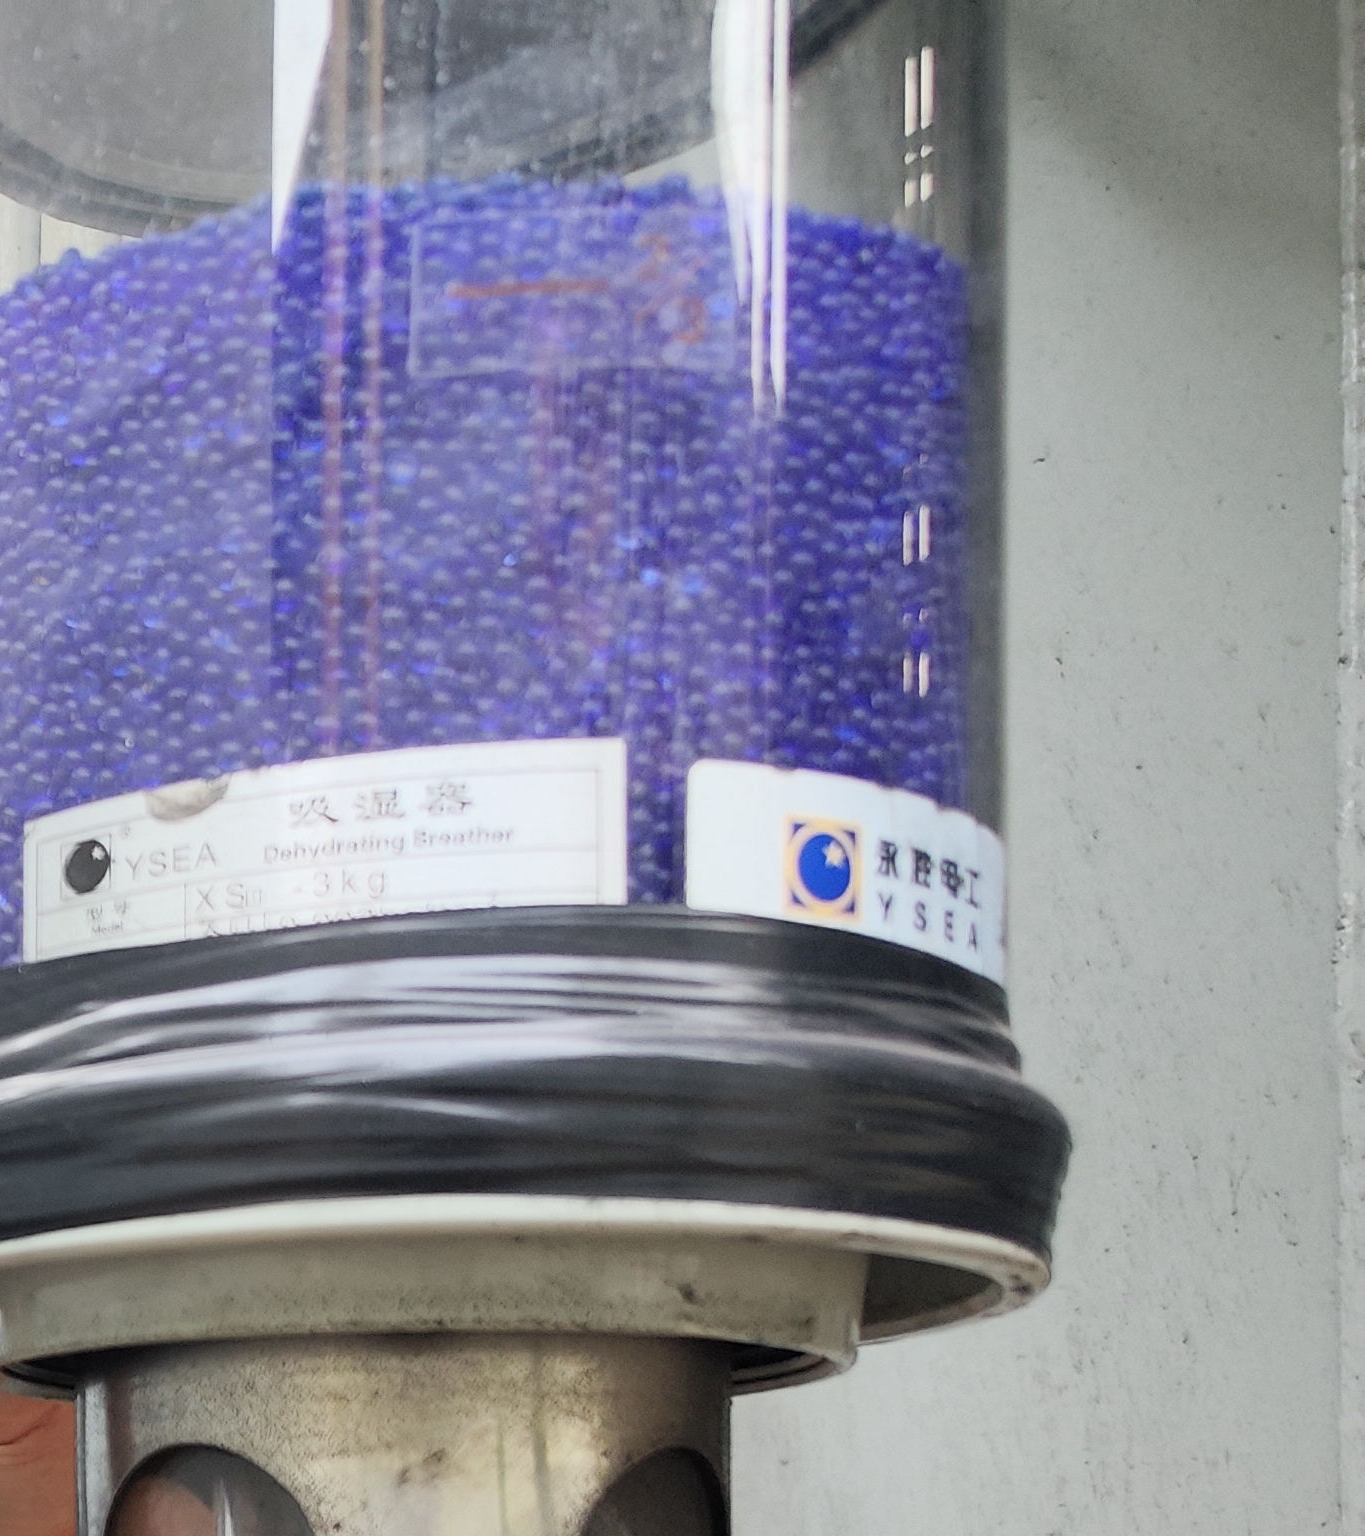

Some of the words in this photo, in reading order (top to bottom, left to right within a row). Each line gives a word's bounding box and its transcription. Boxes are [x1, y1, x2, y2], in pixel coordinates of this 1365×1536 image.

[289, 783, 474, 826] 吸湿器
[125, 843, 218, 880] YSEA
[263, 833, 405, 865] Dehydrating
[412, 825, 516, 849] Breather
[877, 892, 978, 953] YSEA
